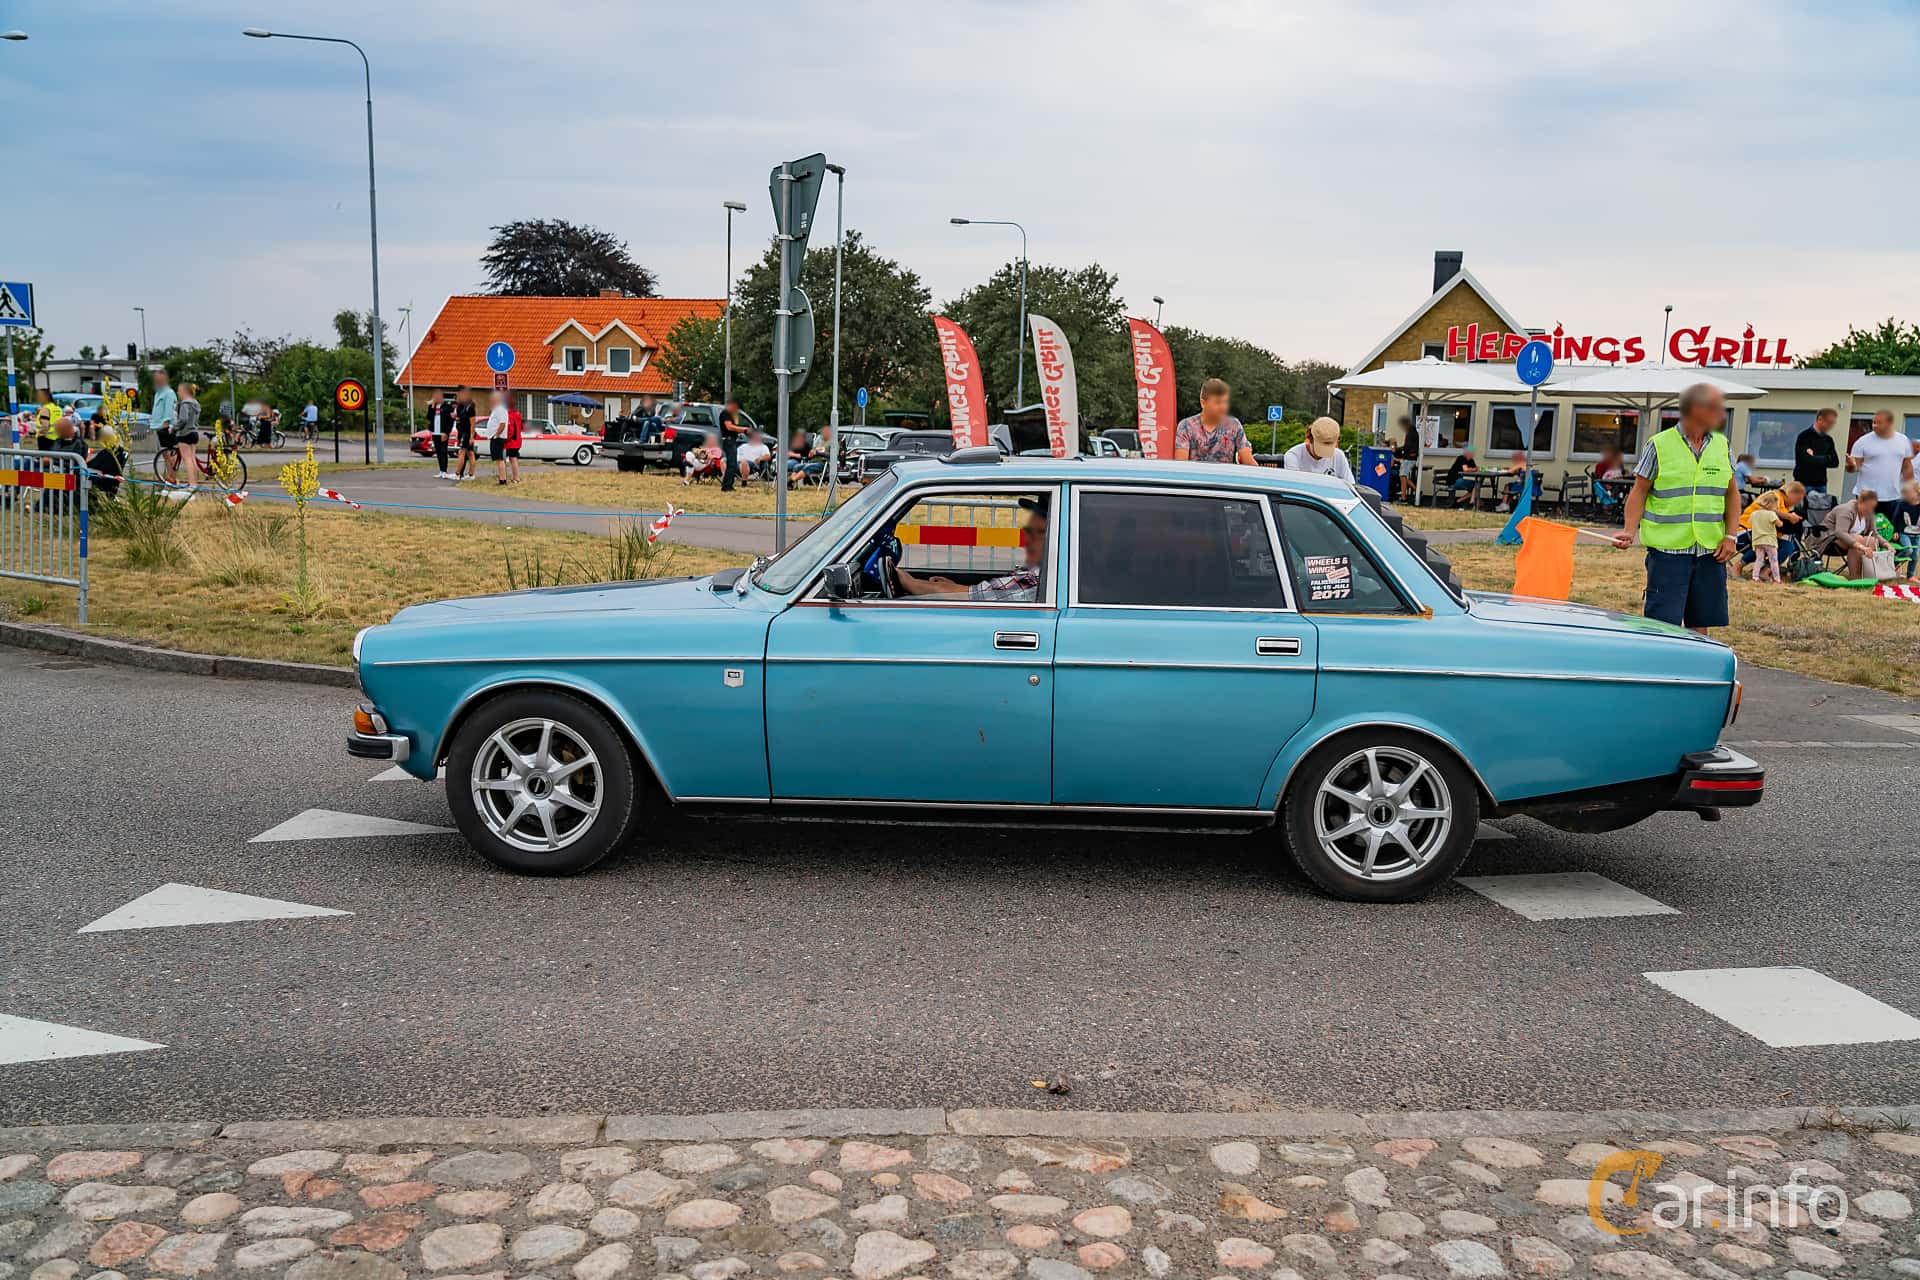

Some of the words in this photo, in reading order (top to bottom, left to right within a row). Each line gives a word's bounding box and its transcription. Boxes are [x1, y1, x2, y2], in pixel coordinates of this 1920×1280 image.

[342, 388, 360, 402] 30
[1307, 558, 1341, 567] WHEELS
[1308, 566, 1336, 574] WINGS
[1312, 589, 1351, 600] 2017
